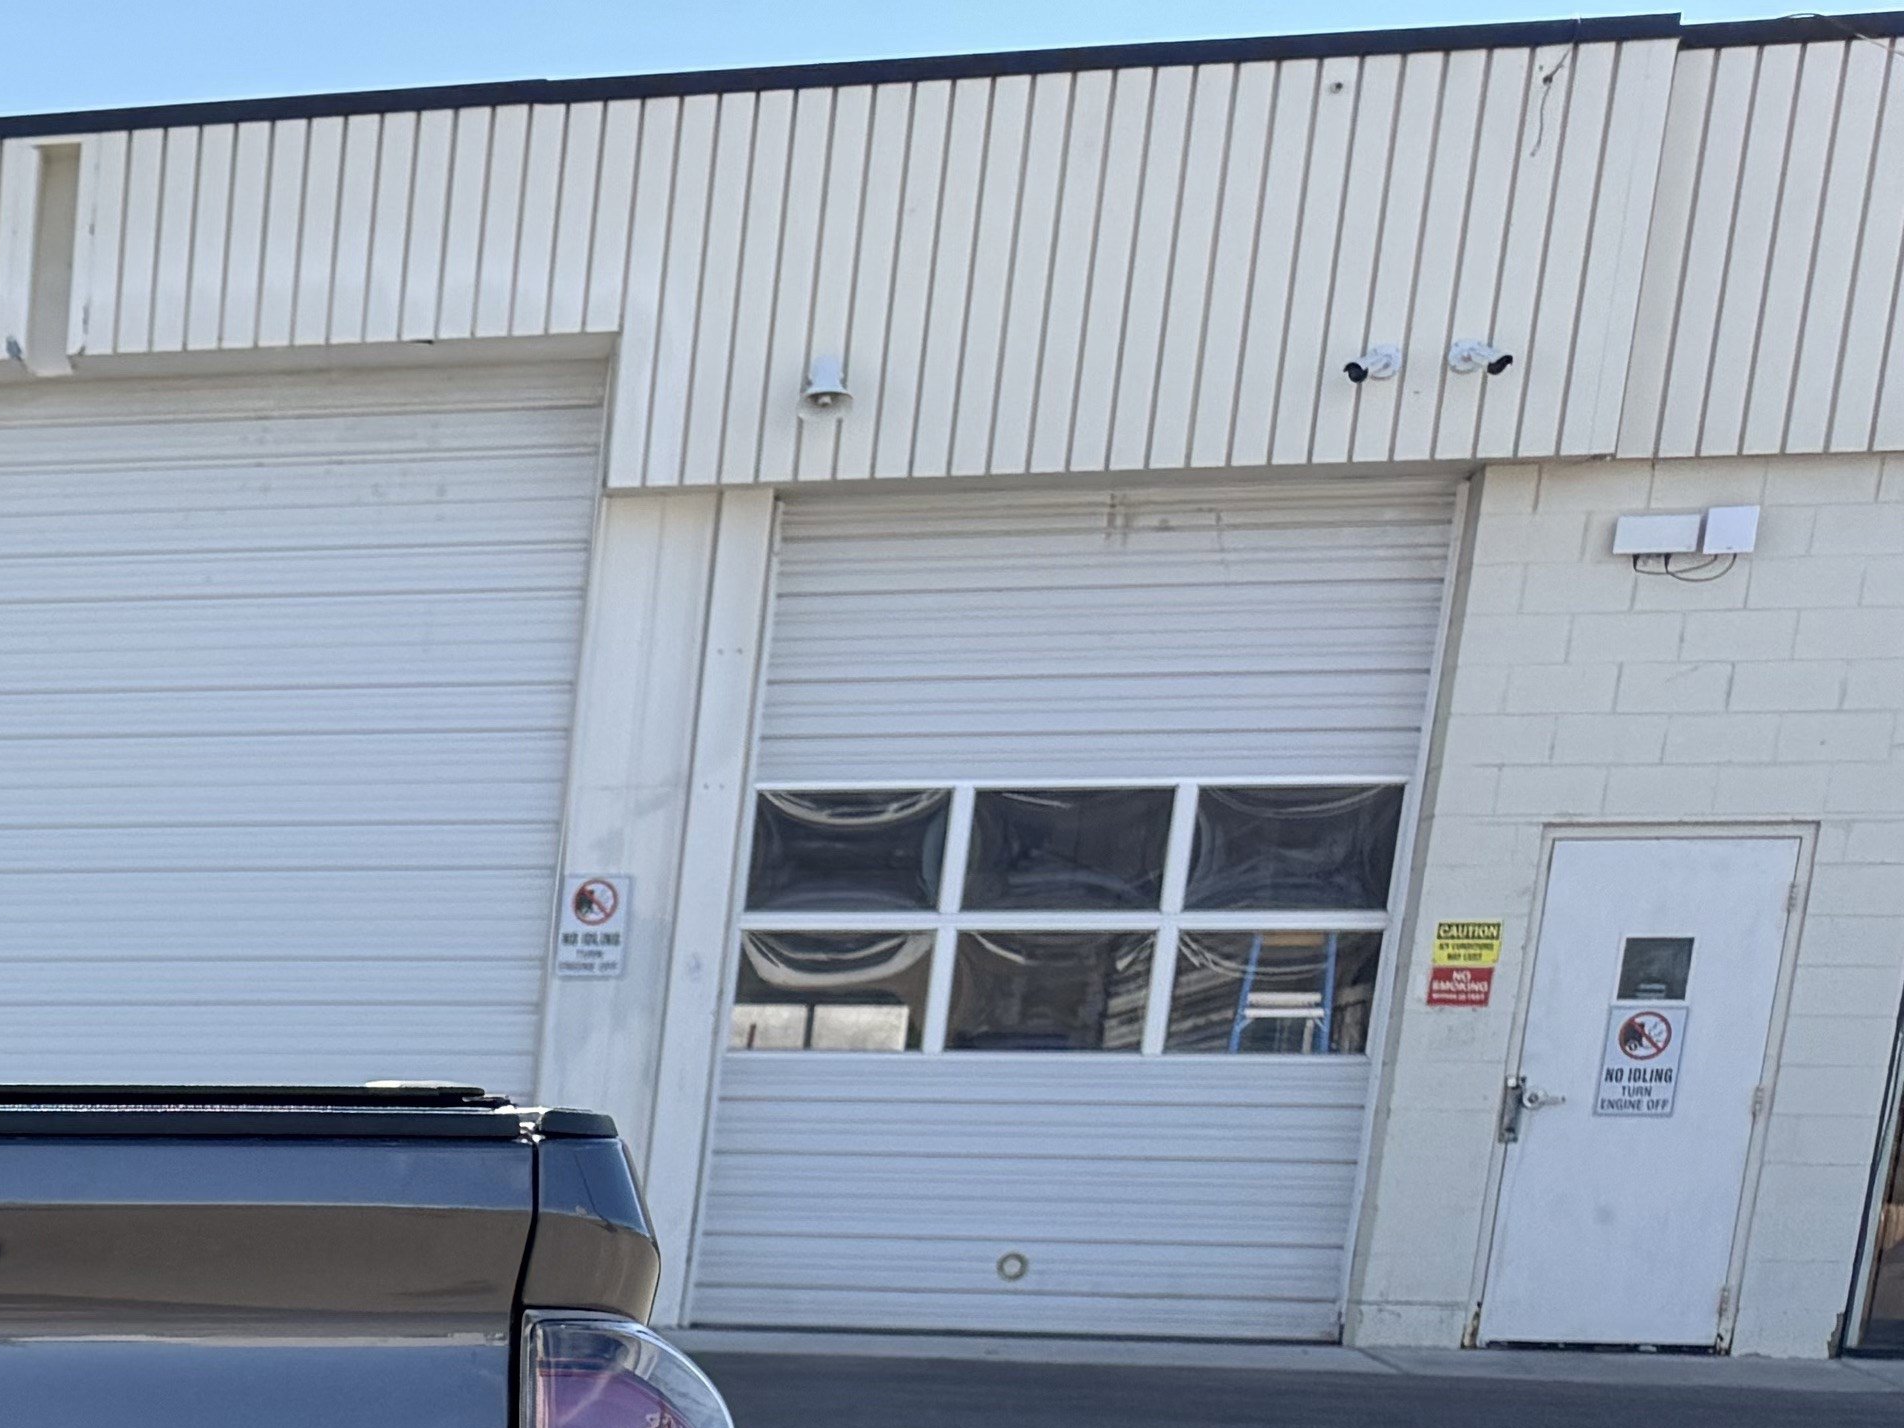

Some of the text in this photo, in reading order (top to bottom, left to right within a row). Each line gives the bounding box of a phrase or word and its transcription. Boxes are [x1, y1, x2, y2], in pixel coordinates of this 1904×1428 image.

[1438, 924, 1499, 938] CAUTION
[1452, 969, 1472, 983] NO
[1604, 1067, 1673, 1083] NO IDLING
[1622, 1085, 1653, 1098] TURN
[1600, 1098, 1669, 1111] ENGINE OFF
